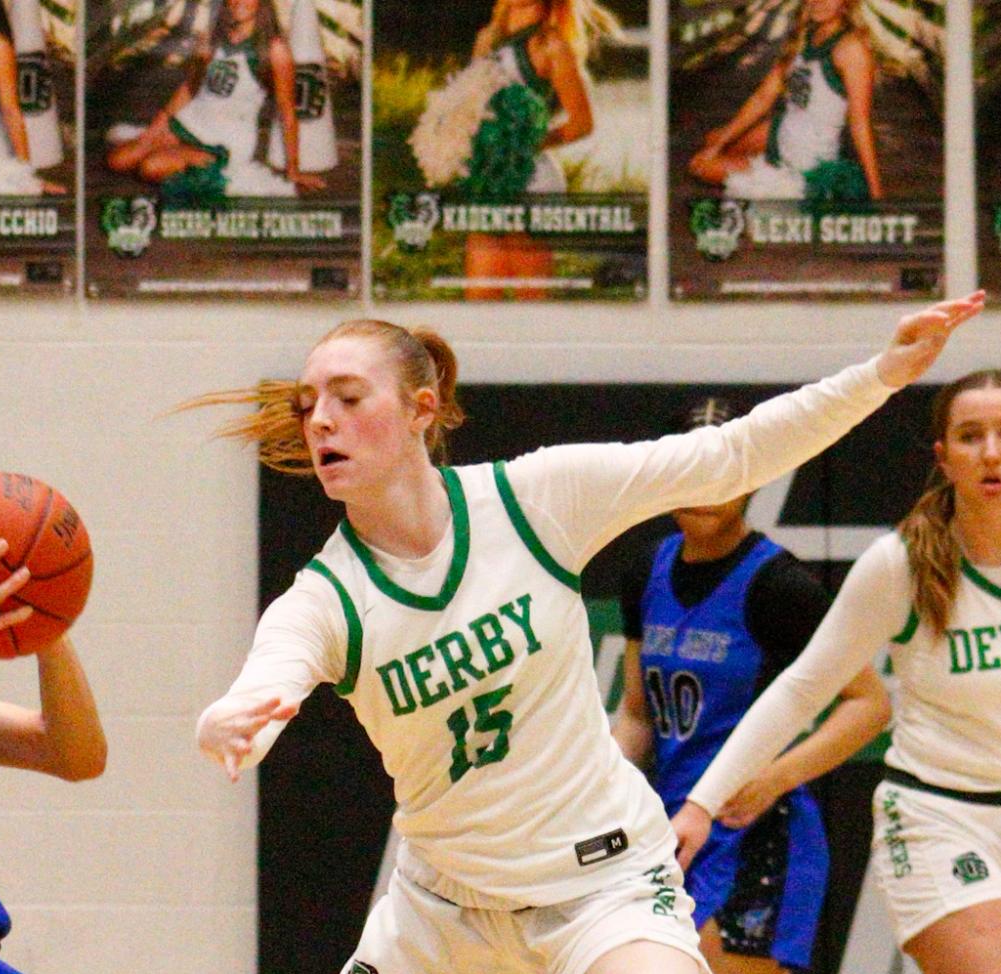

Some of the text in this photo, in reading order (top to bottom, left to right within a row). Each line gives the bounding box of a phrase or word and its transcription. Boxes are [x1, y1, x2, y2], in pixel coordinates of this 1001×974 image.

[751, 215, 918, 243] LEXI SCHOTT
[376, 593, 543, 717] DERBY
[446, 683, 514, 784] 15
[646, 666, 704, 742] 10
[611, 837, 622, 849] M
